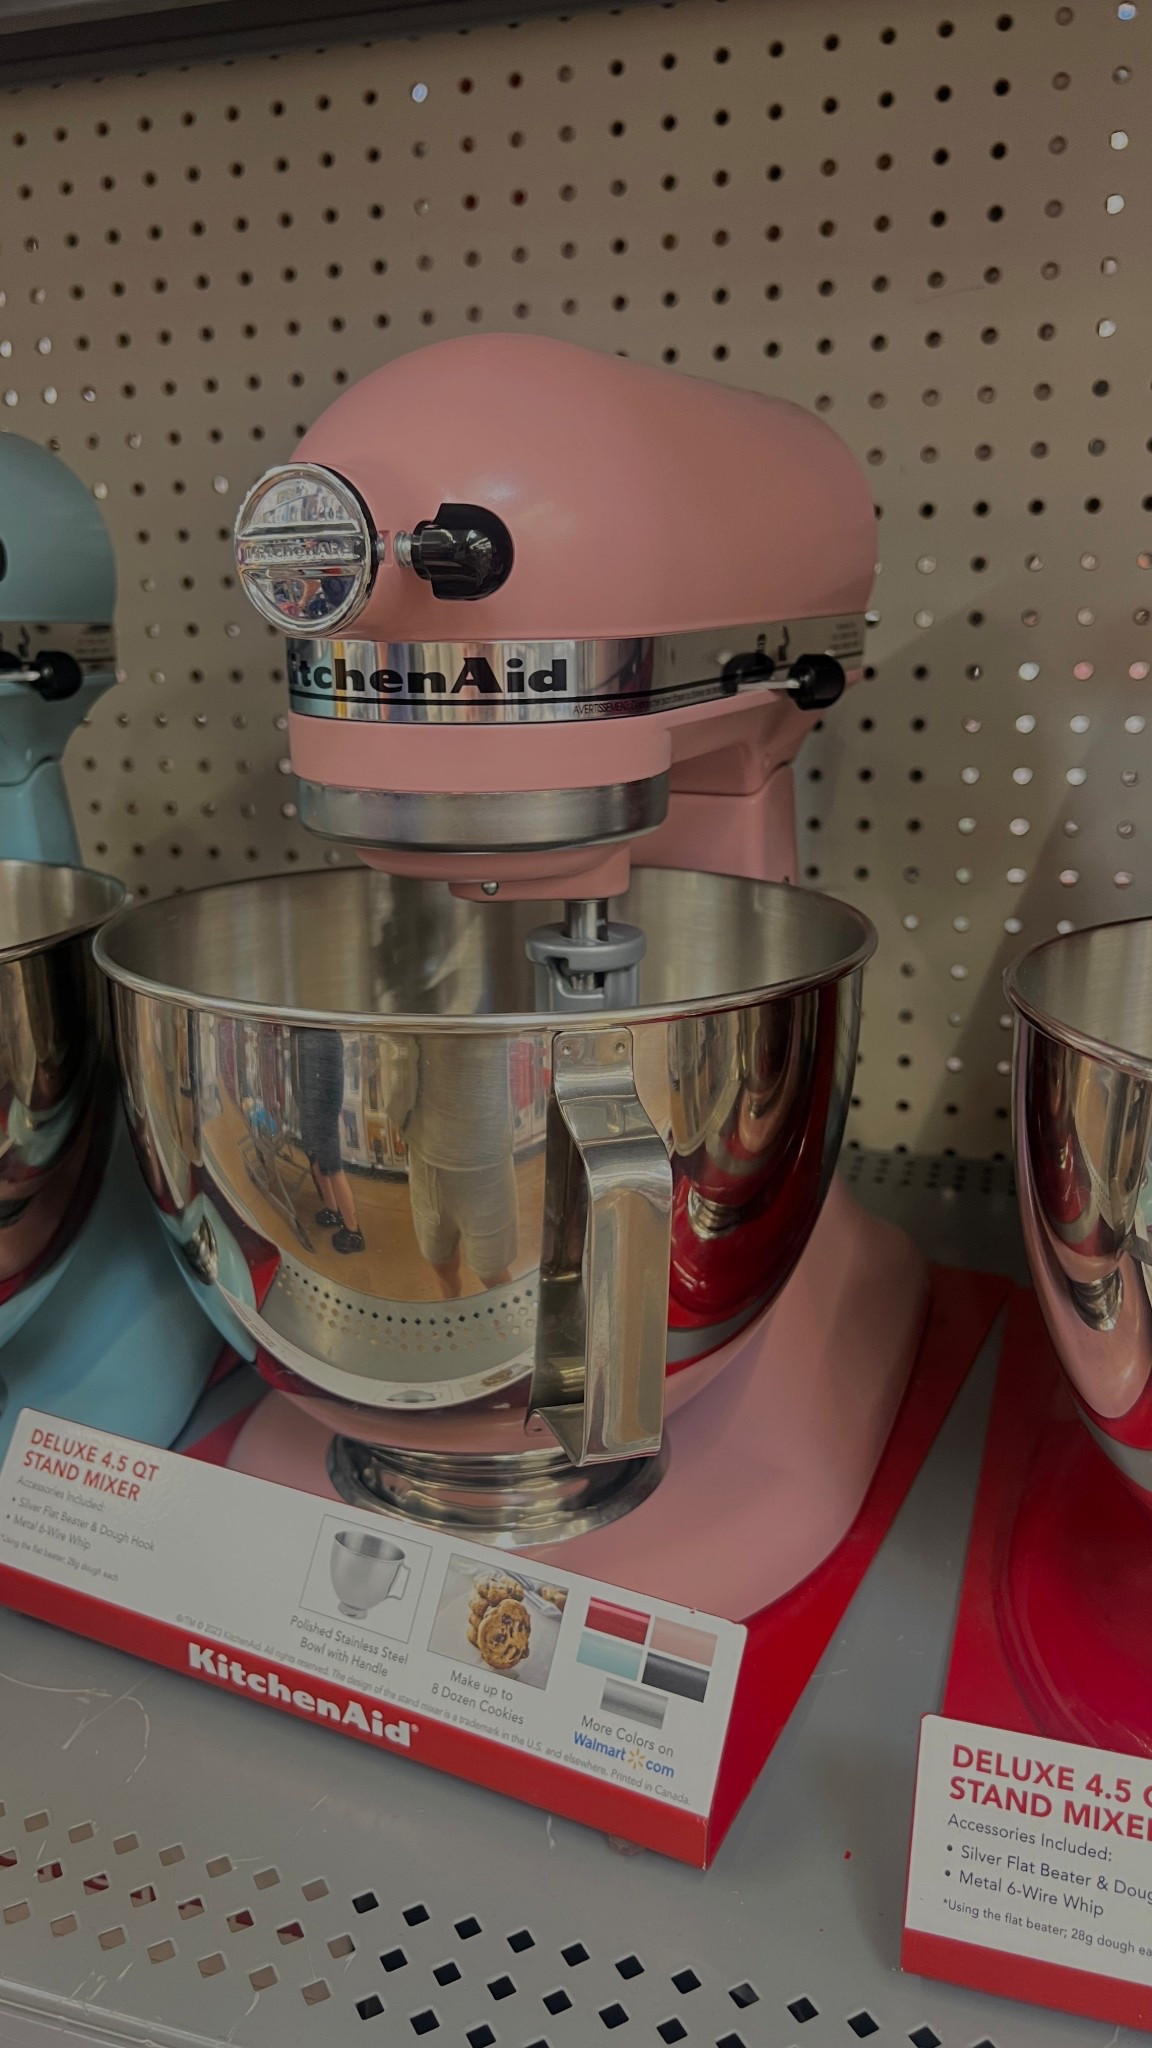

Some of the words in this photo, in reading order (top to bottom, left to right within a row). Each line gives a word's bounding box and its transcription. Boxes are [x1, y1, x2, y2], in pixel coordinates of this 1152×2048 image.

[288, 653, 567, 693] itchenAid
[23, 1450, 79, 1481] STAND
[83, 1469, 141, 1501] MIXER
[31, 1428, 99, 1463] DELUXE
[101, 1451, 129, 1473] 4.5
[132, 1461, 160, 1482] QT
[17, 1476, 65, 1500] Accessories
[66, 1491, 106, 1513] Included:
[13, 1514, 39, 1531] Metal
[38, 1523, 67, 1542] 6-Wire
[69, 1533, 91, 1552] Whip
[18, 1497, 41, 1513] Silver
[42, 1504, 59, 1520] Flat
[60, 1511, 89, 1529] Beater
[90, 1521, 98, 1533] &
[100, 1524, 130, 1544] Dough
[131, 1534, 156, 1552] Hook
[290, 1615, 335, 1639] Polished
[335, 1630, 380, 1655] Stainless
[381, 1646, 409, 1665] Steel
[300, 1636, 326, 1655] Bowl
[327, 1648, 349, 1664] with
[351, 1654, 389, 1677] Handle
[431, 1682, 440, 1695] 8
[441, 1685, 476, 1708] Dozen
[479, 1700, 525, 1726] Cookies
[450, 1669, 481, 1690] Make
[483, 1684, 498, 1699] up
[501, 1689, 514, 1702] to
[276, 1650, 295, 1663] rights
[332, 1668, 346, 1681] The
[347, 1675, 373, 1691] design
[374, 1685, 384, 1694] of
[384, 1688, 397, 1700] the
[398, 1694, 420, 1708] stand
[421, 1703, 443, 1716] mixer
[444, 1710, 451, 1719] is
[452, 1714, 458, 1722] a
[459, 1715, 500, 1736] trademark
[501, 1730, 510, 1740] in
[511, 1733, 525, 1746] the
[526, 1737, 543, 1751] U.S.
[545, 1747, 563, 1760] and
[564, 1752, 609, 1777] elsewhere.
[610, 1769, 643, 1788] Printed
[644, 1781, 653, 1792] in
[655, 1784, 692, 1806] Canada.
[573, 1730, 626, 1761] Walmart
[580, 1714, 613, 1736] More
[616, 1727, 655, 1751] Colors
[658, 1744, 675, 1758] on
[949, 1775, 1053, 1818] STAND
[952, 1743, 1075, 1792] DELUXE
[1085, 1773, 1132, 1804] 4.5
[947, 1813, 1036, 1845] Accessories
[1041, 1833, 1113, 1862] Included:
[959, 1870, 1002, 1893] Metal
[1007, 1881, 1058, 1905] 6-Wire
[1063, 1893, 1104, 1919] Whip
[961, 1845, 1002, 1867] Silver
[1007, 1856, 1036, 1875] Flat
[1040, 1863, 1092, 1887] Beater
[1096, 1875, 1109, 1891] &
[1114, 1879, 1152, 1906] Doug
[983, 1907, 1001, 1921] the
[1005, 1912, 1023, 1927] flat
[1026, 1917, 1067, 1939] beater;
[1071, 1928, 1093, 1946] 28g
[1097, 1935, 1135, 1954] dough
[1139, 1946, 1152, 1957] ea
